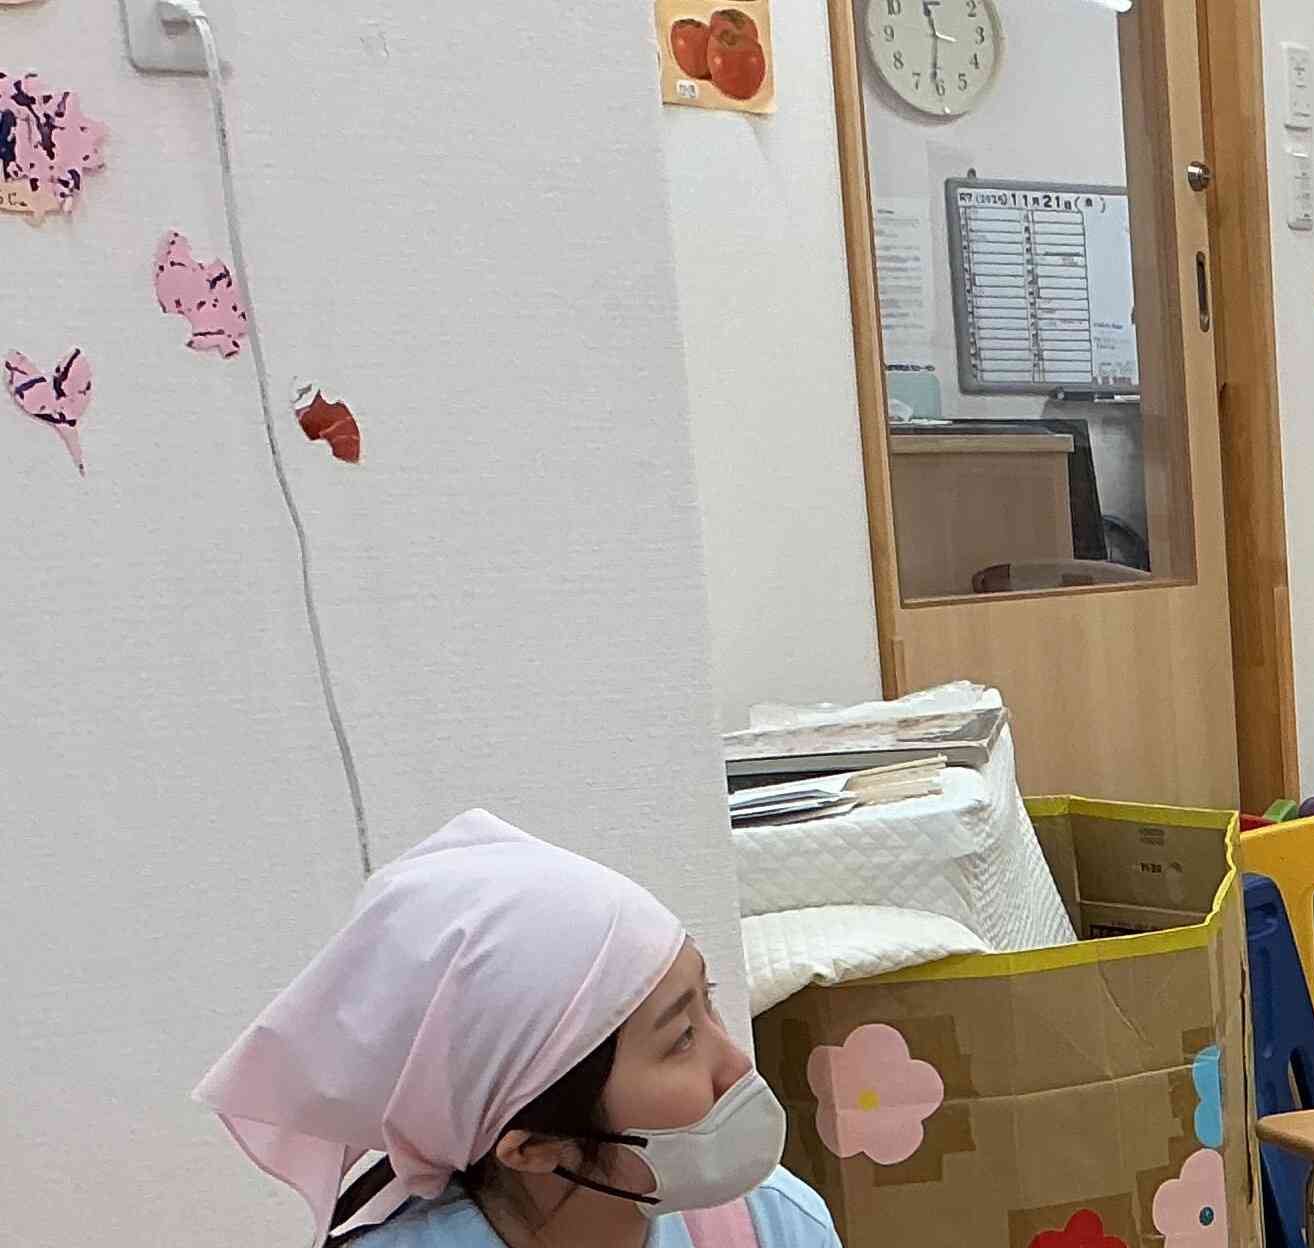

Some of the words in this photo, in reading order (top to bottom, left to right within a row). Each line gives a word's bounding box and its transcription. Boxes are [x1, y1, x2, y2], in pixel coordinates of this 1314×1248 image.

[967, 0, 977, 17] 2
[883, 24, 895, 42] 9
[975, 25, 985, 45] 3
[893, 51, 904, 70] 8
[968, 53, 979, 70] 4
[912, 72, 921, 90] 7
[935, 79, 945, 97] 6
[958, 73, 968, 91] 5
